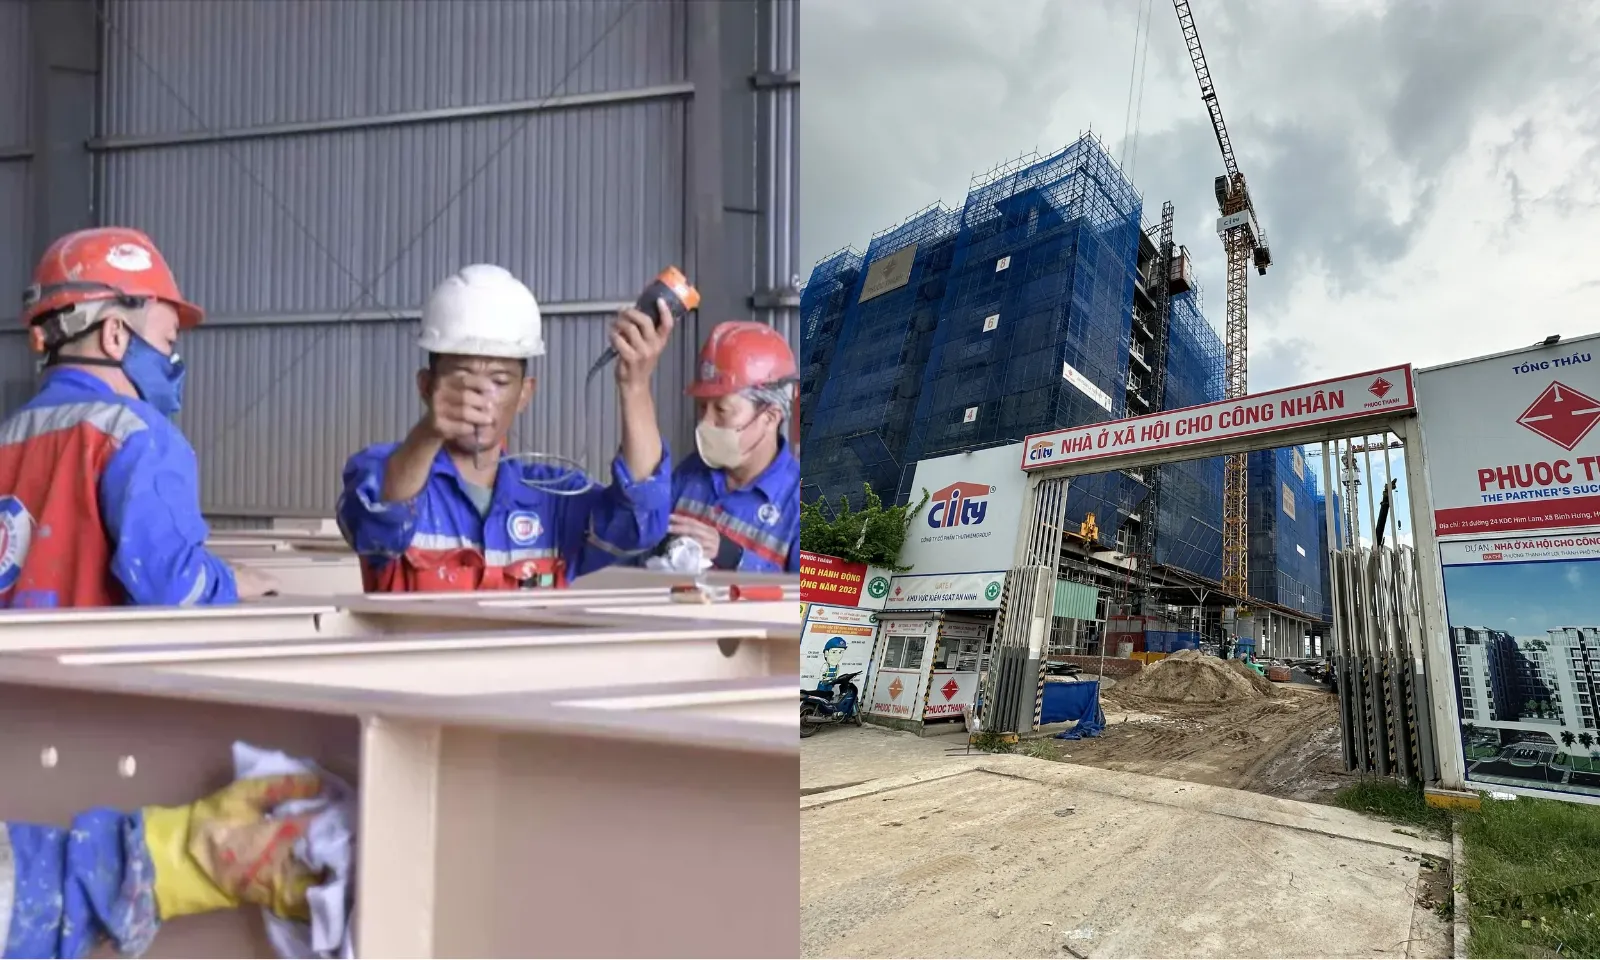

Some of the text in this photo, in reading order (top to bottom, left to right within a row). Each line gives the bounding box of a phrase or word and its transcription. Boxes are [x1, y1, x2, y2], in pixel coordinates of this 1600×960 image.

[1512, 352, 1591, 375] TỔNG THẦU
[967, 409, 974, 420] 4
[1061, 390, 1344, 454] NHÀ Ở XÃ HỘI CHO CÔNG NHÂN
[1478, 456, 1600, 491] PHUOC T
[1481, 484, 1600, 502] THE PARTNER'S SUC
[1494, 540, 1512, 551] NHÀ
[1522, 540, 1535, 549] XÃ
[1536, 538, 1552, 549] HỘI
[1554, 538, 1574, 547] CHO
[818, 567, 839, 579] HÀNH
[841, 572, 860, 582] ĐỘNG
[819, 581, 837, 592] NĂM
[838, 585, 857, 594] 2023
